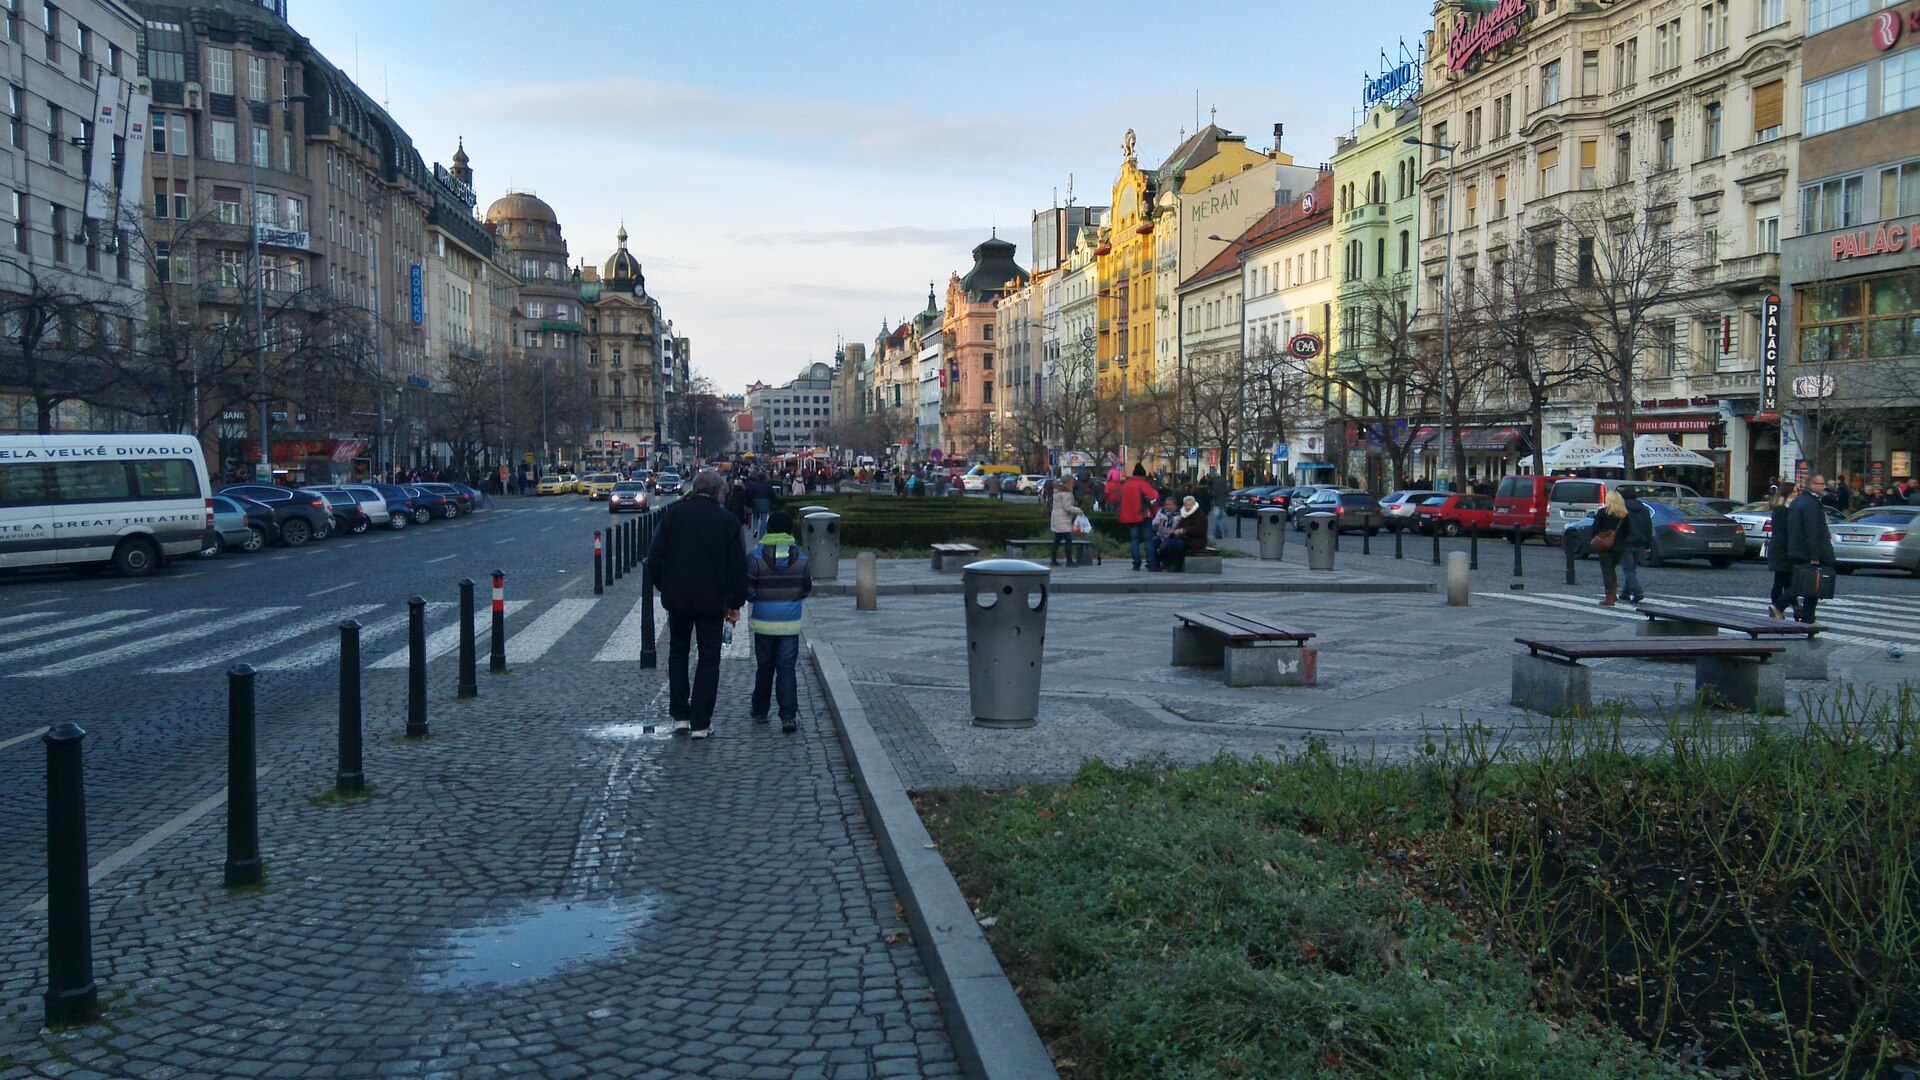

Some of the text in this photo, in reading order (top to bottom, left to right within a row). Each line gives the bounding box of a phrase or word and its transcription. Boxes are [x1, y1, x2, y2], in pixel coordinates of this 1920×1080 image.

[1447, 0, 1527, 71] Budweiser
[1481, 23, 1519, 55] Budvar
[1367, 64, 1411, 102] CASINO
[1192, 189, 1238, 222] MERAN
[1831, 222, 1904, 261] PALÁC
[412, 268, 421, 323] ROKOKO
[1296, 340, 1316, 352] C&A
[1767, 305, 1778, 360] PALÁC
[1765, 365, 1776, 409] KNIH
[223, 411, 246, 420] BANK
[1636, 422, 1658, 430] TYPICAL
[1660, 421, 1677, 429] CZECH
[1679, 421, 1715, 429] RESTAURA
[45, 445, 107, 457] VELKÉ
[116, 447, 193, 455] DIVADLO
[53, 519, 114, 528] GREAT
[122, 514, 200, 524] THEATRE
